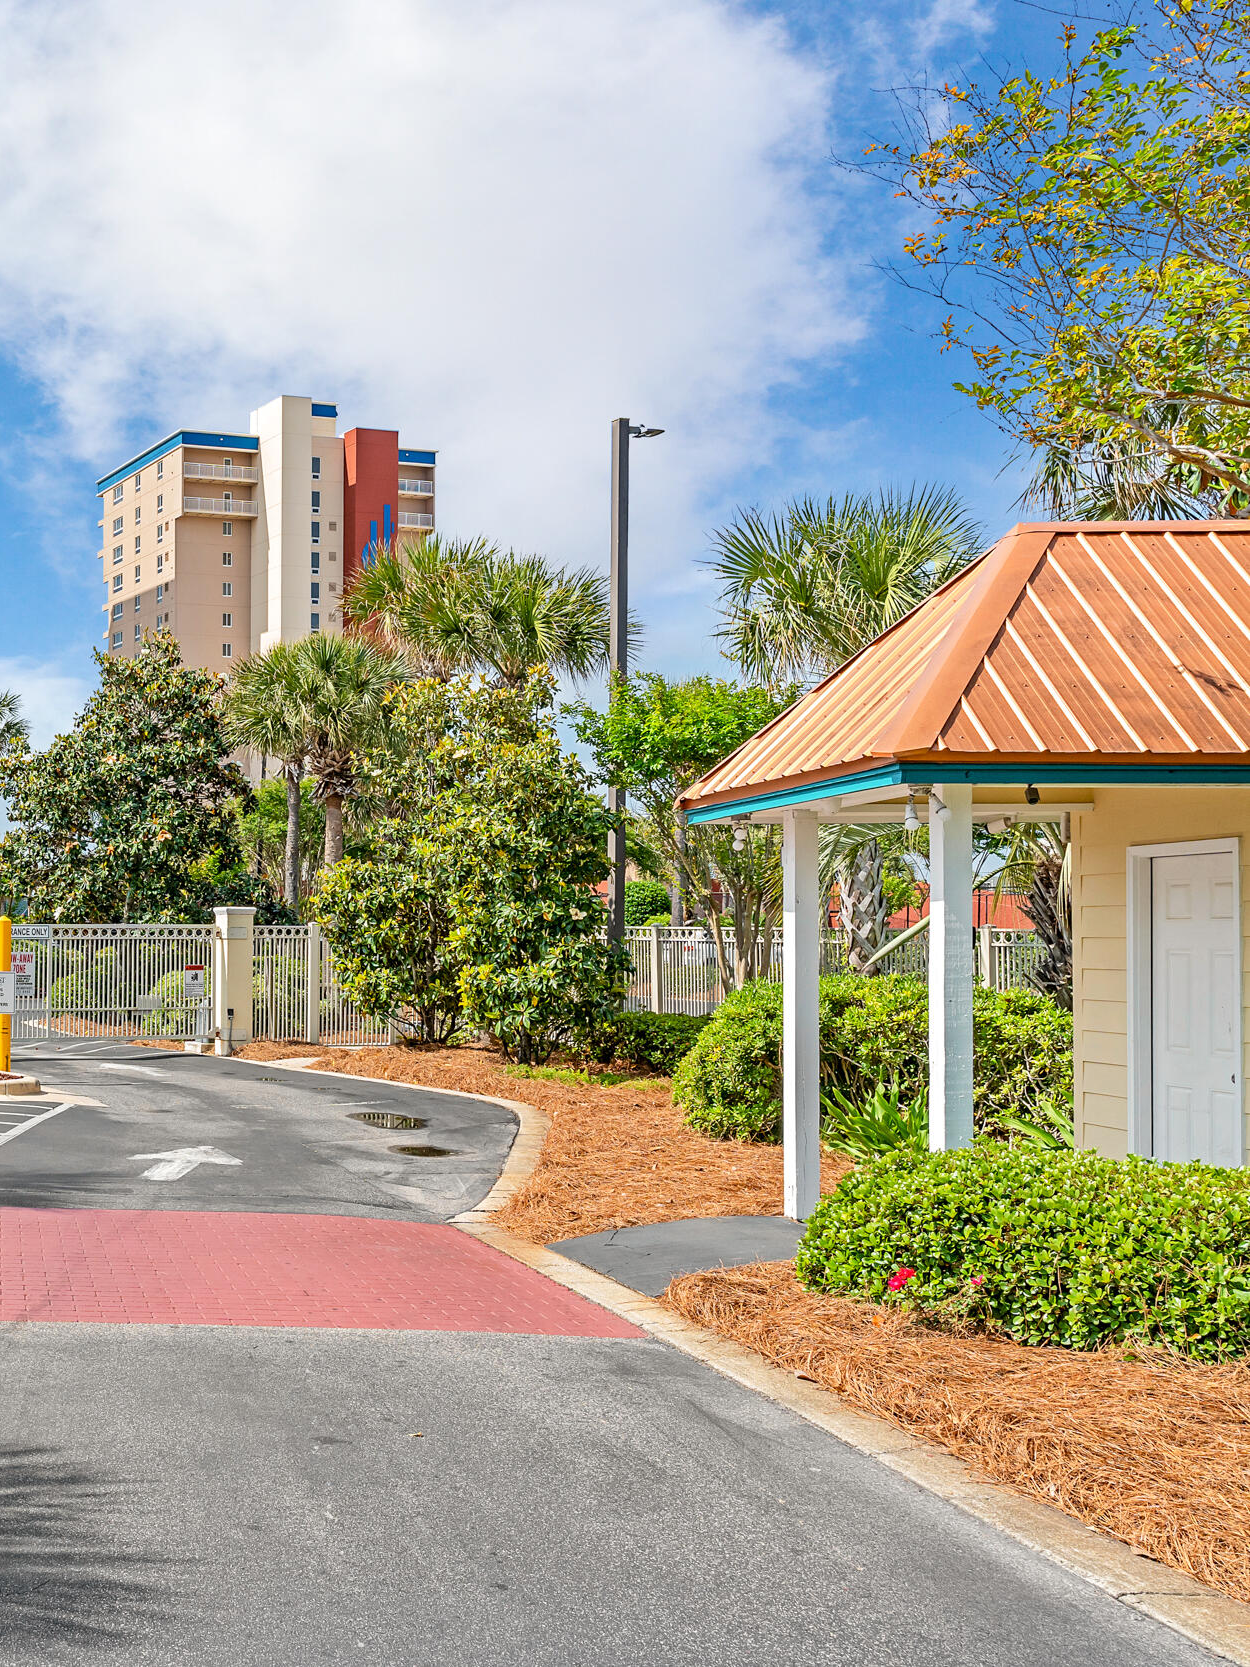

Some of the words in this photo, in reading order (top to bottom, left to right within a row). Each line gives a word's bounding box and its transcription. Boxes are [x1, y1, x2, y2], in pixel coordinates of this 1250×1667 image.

[11, 928, 30, 936] RANCE
[31, 928, 47, 936] ONLY
[11, 953, 34, 963] W-AWAY
